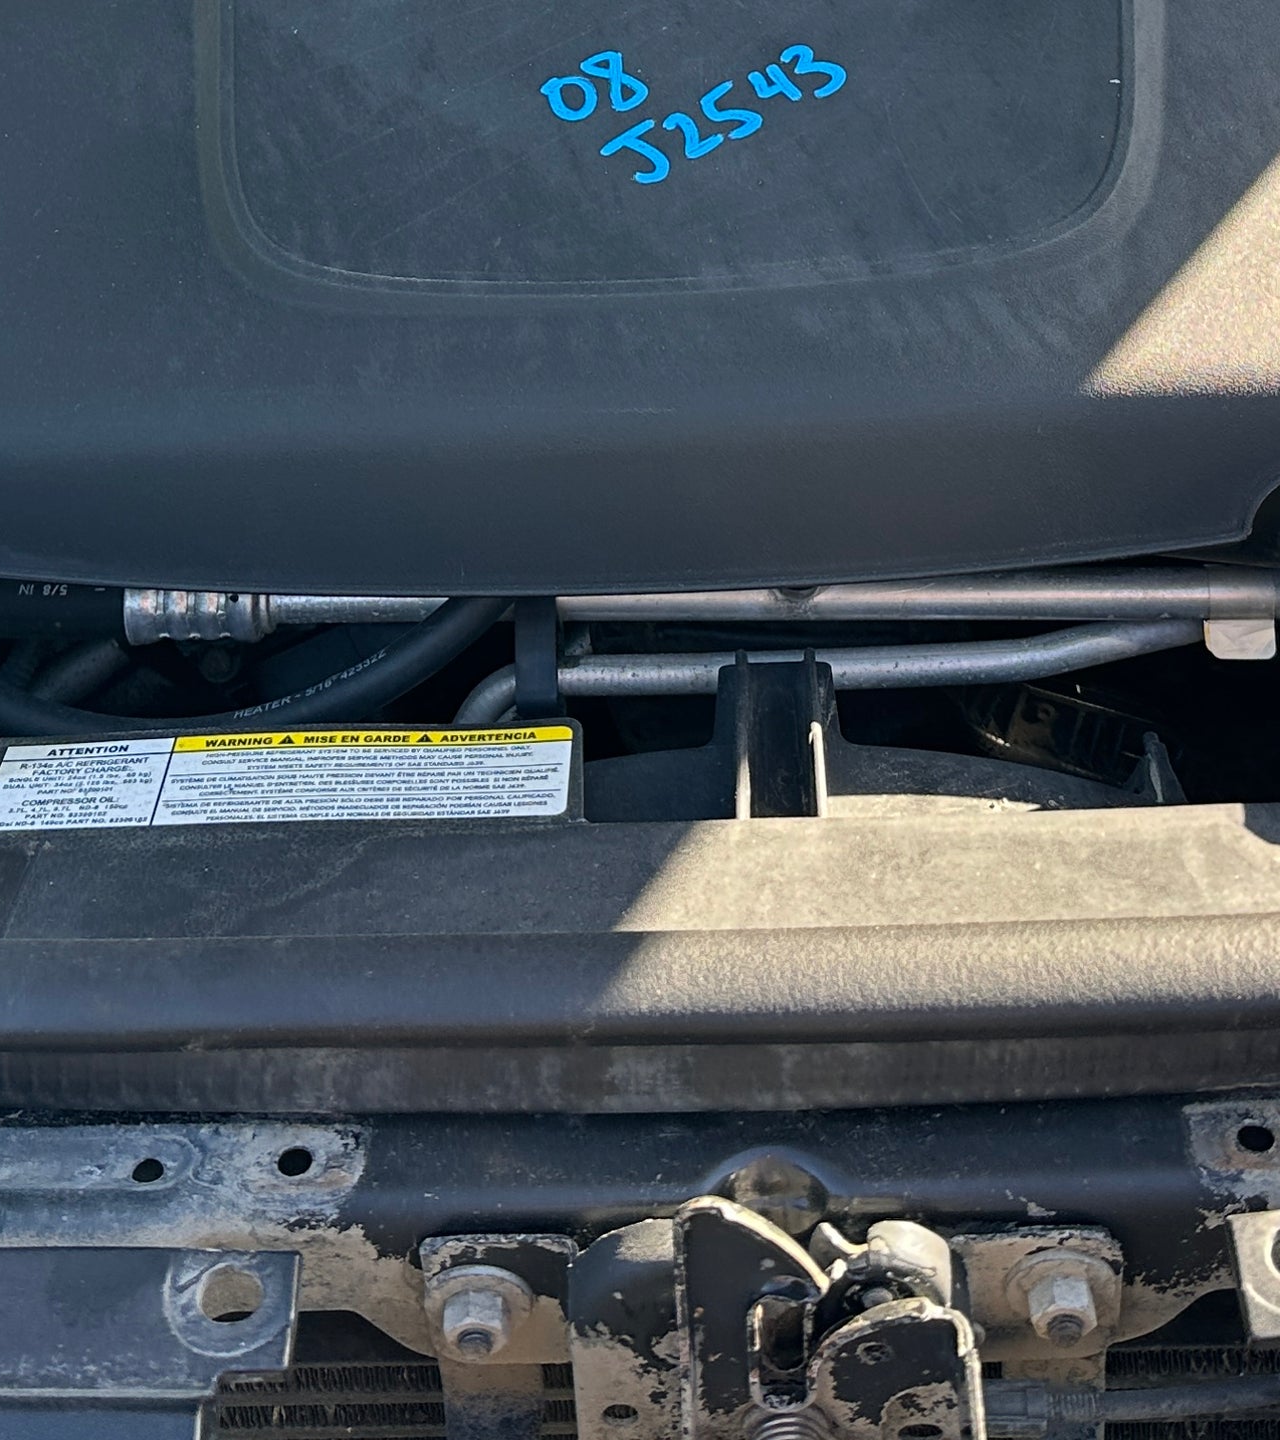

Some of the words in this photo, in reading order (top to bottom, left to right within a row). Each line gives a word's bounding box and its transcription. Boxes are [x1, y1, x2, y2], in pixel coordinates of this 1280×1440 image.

[540, 50, 649, 122] 08
[600, 43, 848, 186] J2543
[18, 584, 34, 595] IN
[42, 584, 68, 597] 5/8
[233, 696, 291, 719] HEATER
[205, 737, 273, 748] WARNING
[303, 735, 337, 744] MISE
[341, 735, 360, 743] EN
[363, 735, 410, 743] GARDE
[440, 732, 537, 743] ADVERTENCIA
[47, 744, 130, 756] ATTENTION
[20, 762, 54, 770] R-134a
[56, 761, 73, 769] A/C
[75, 756, 150, 767] REFRIGERANT
[32, 767, 83, 776] FACTORY
[218, 774, 275, 782] CLIMATISATION
[179, 783, 222, 791] CONSULTER
[21, 797, 96, 807] COMPRESSOR
[213, 799, 270, 807] REFRIGERANTE
[170, 808, 208, 816] CONSULTE
